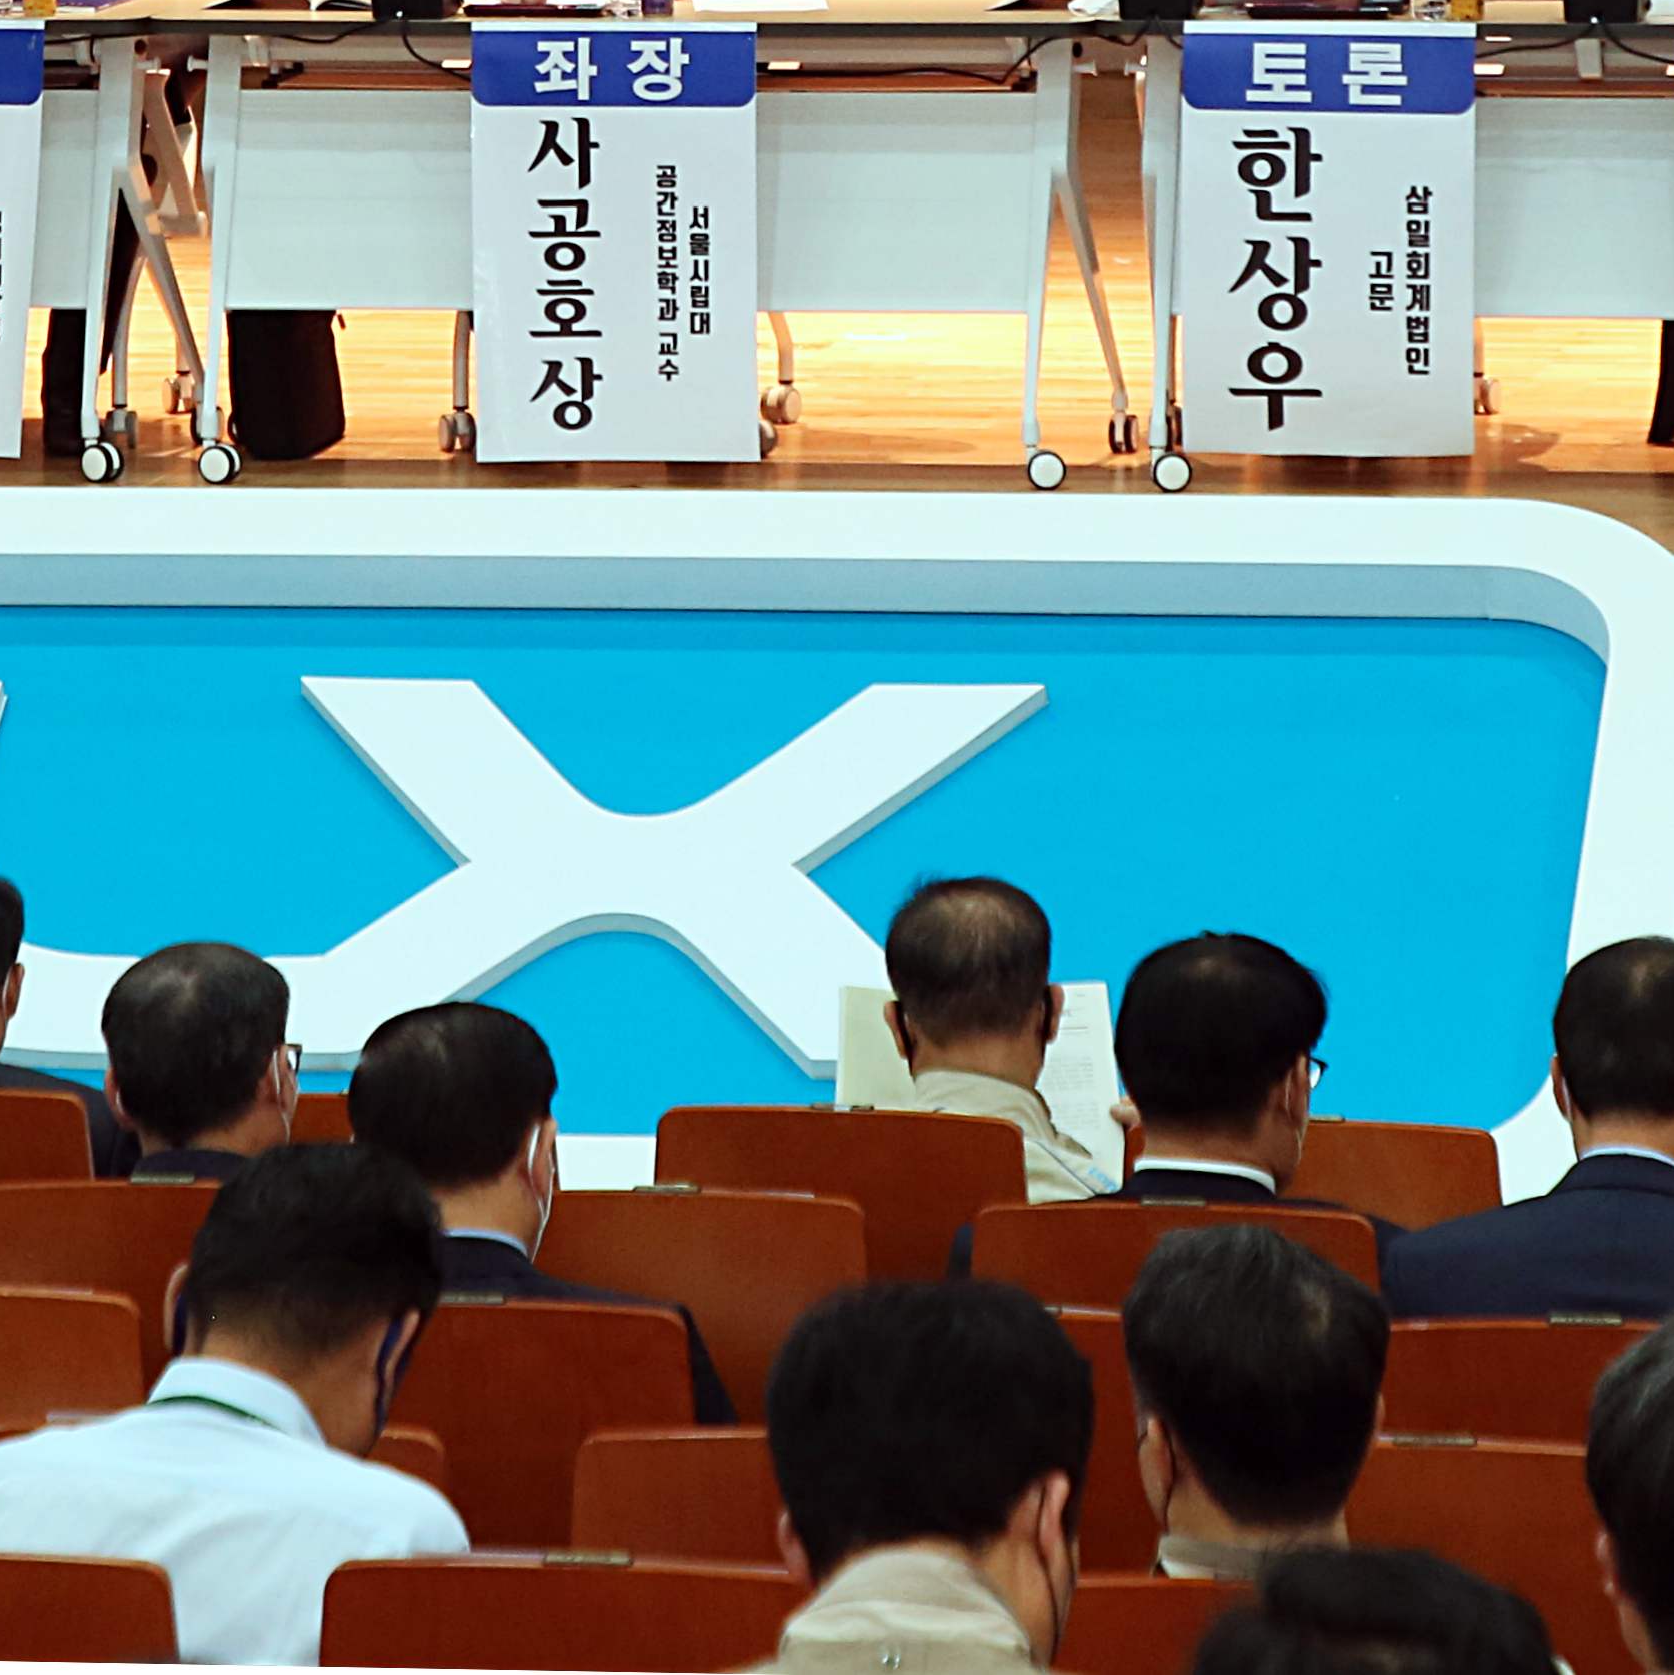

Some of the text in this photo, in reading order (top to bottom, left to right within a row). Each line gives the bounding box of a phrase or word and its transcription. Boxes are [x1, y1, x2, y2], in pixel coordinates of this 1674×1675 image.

[527, 117, 603, 431] 사공호상
[655, 164, 680, 382] 공간정보학과 교수
[688, 205, 711, 335] 서울시립대
[1228, 126, 1323, 432] 한상우
[1368, 250, 1395, 312] 고문
[1405, 185, 1433, 376] 삼일회계법인
